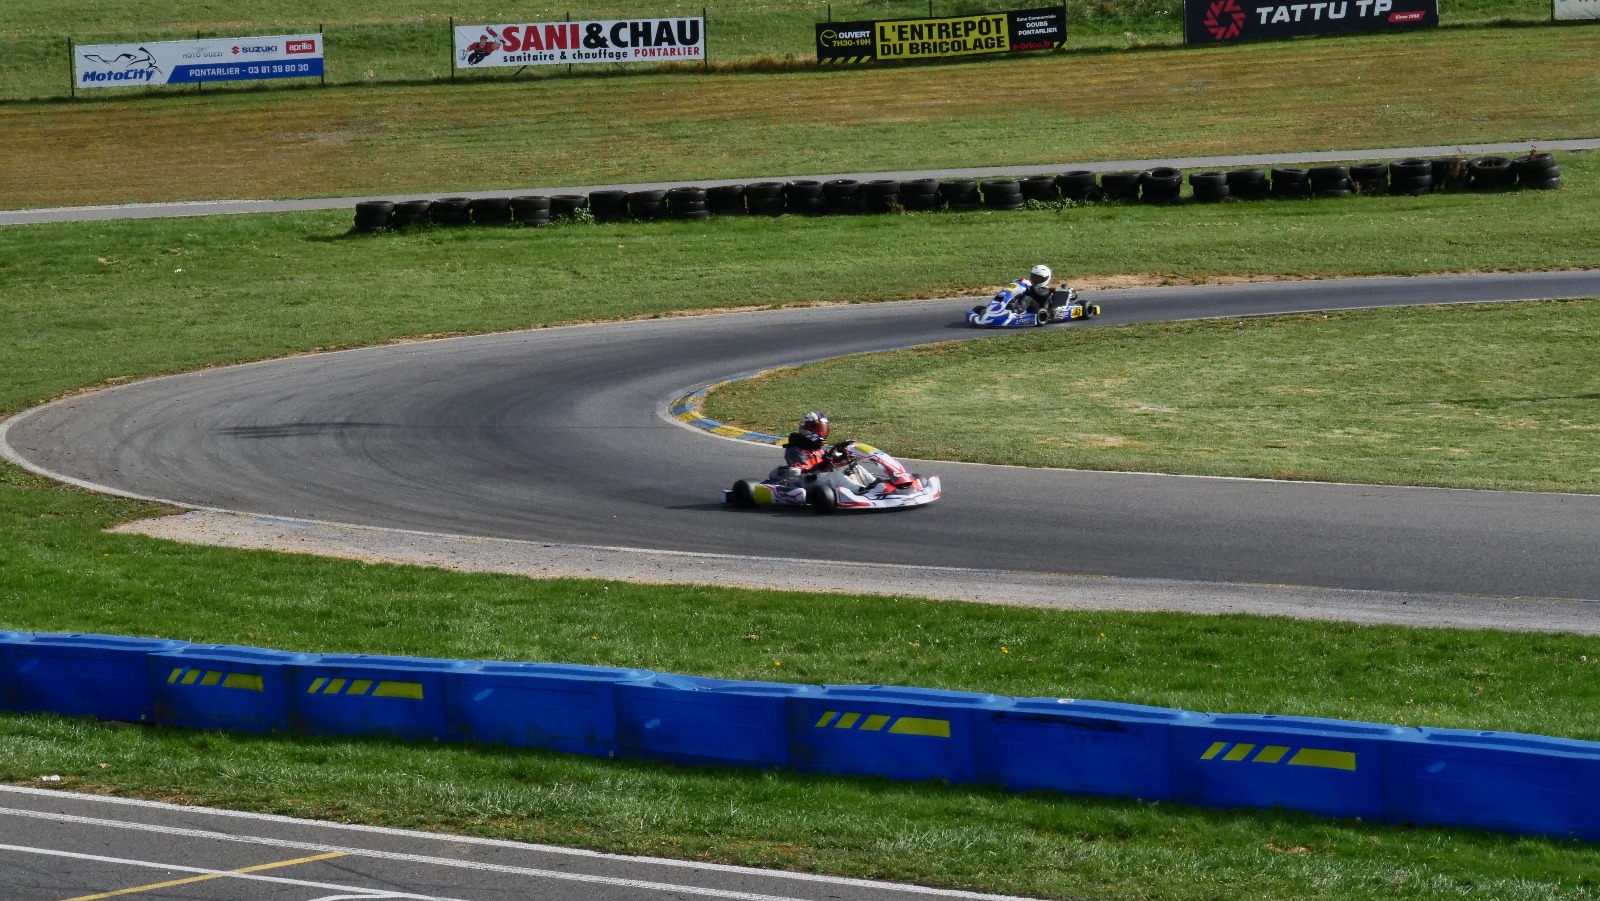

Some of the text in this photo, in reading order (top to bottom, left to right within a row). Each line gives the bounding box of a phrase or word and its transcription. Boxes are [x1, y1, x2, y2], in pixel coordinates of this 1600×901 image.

[1256, 0, 1392, 24] TATTU TP
[880, 17, 1004, 42] L'ENTREPÔT
[1026, 20, 1048, 28] DOUBS
[502, 19, 700, 52] SANI&CHAU
[838, 30, 871, 39] OUVERT
[1018, 27, 1058, 36] PONTARLIER
[241, 45, 278, 54] SUZUKI
[288, 42, 313, 52] aprilia
[881, 36, 1006, 56] DU BRICOLAGE
[503, 46, 700, 63] sanitaire & chauffage PONTARLIER
[82, 68, 155, 82] MotoCity
[189, 67, 240, 77] PONTARLIER
[248, 66, 259, 74] 03
[261, 65, 270, 73] 81
[285, 64, 296, 72] 80
[298, 63, 309, 71] 30
